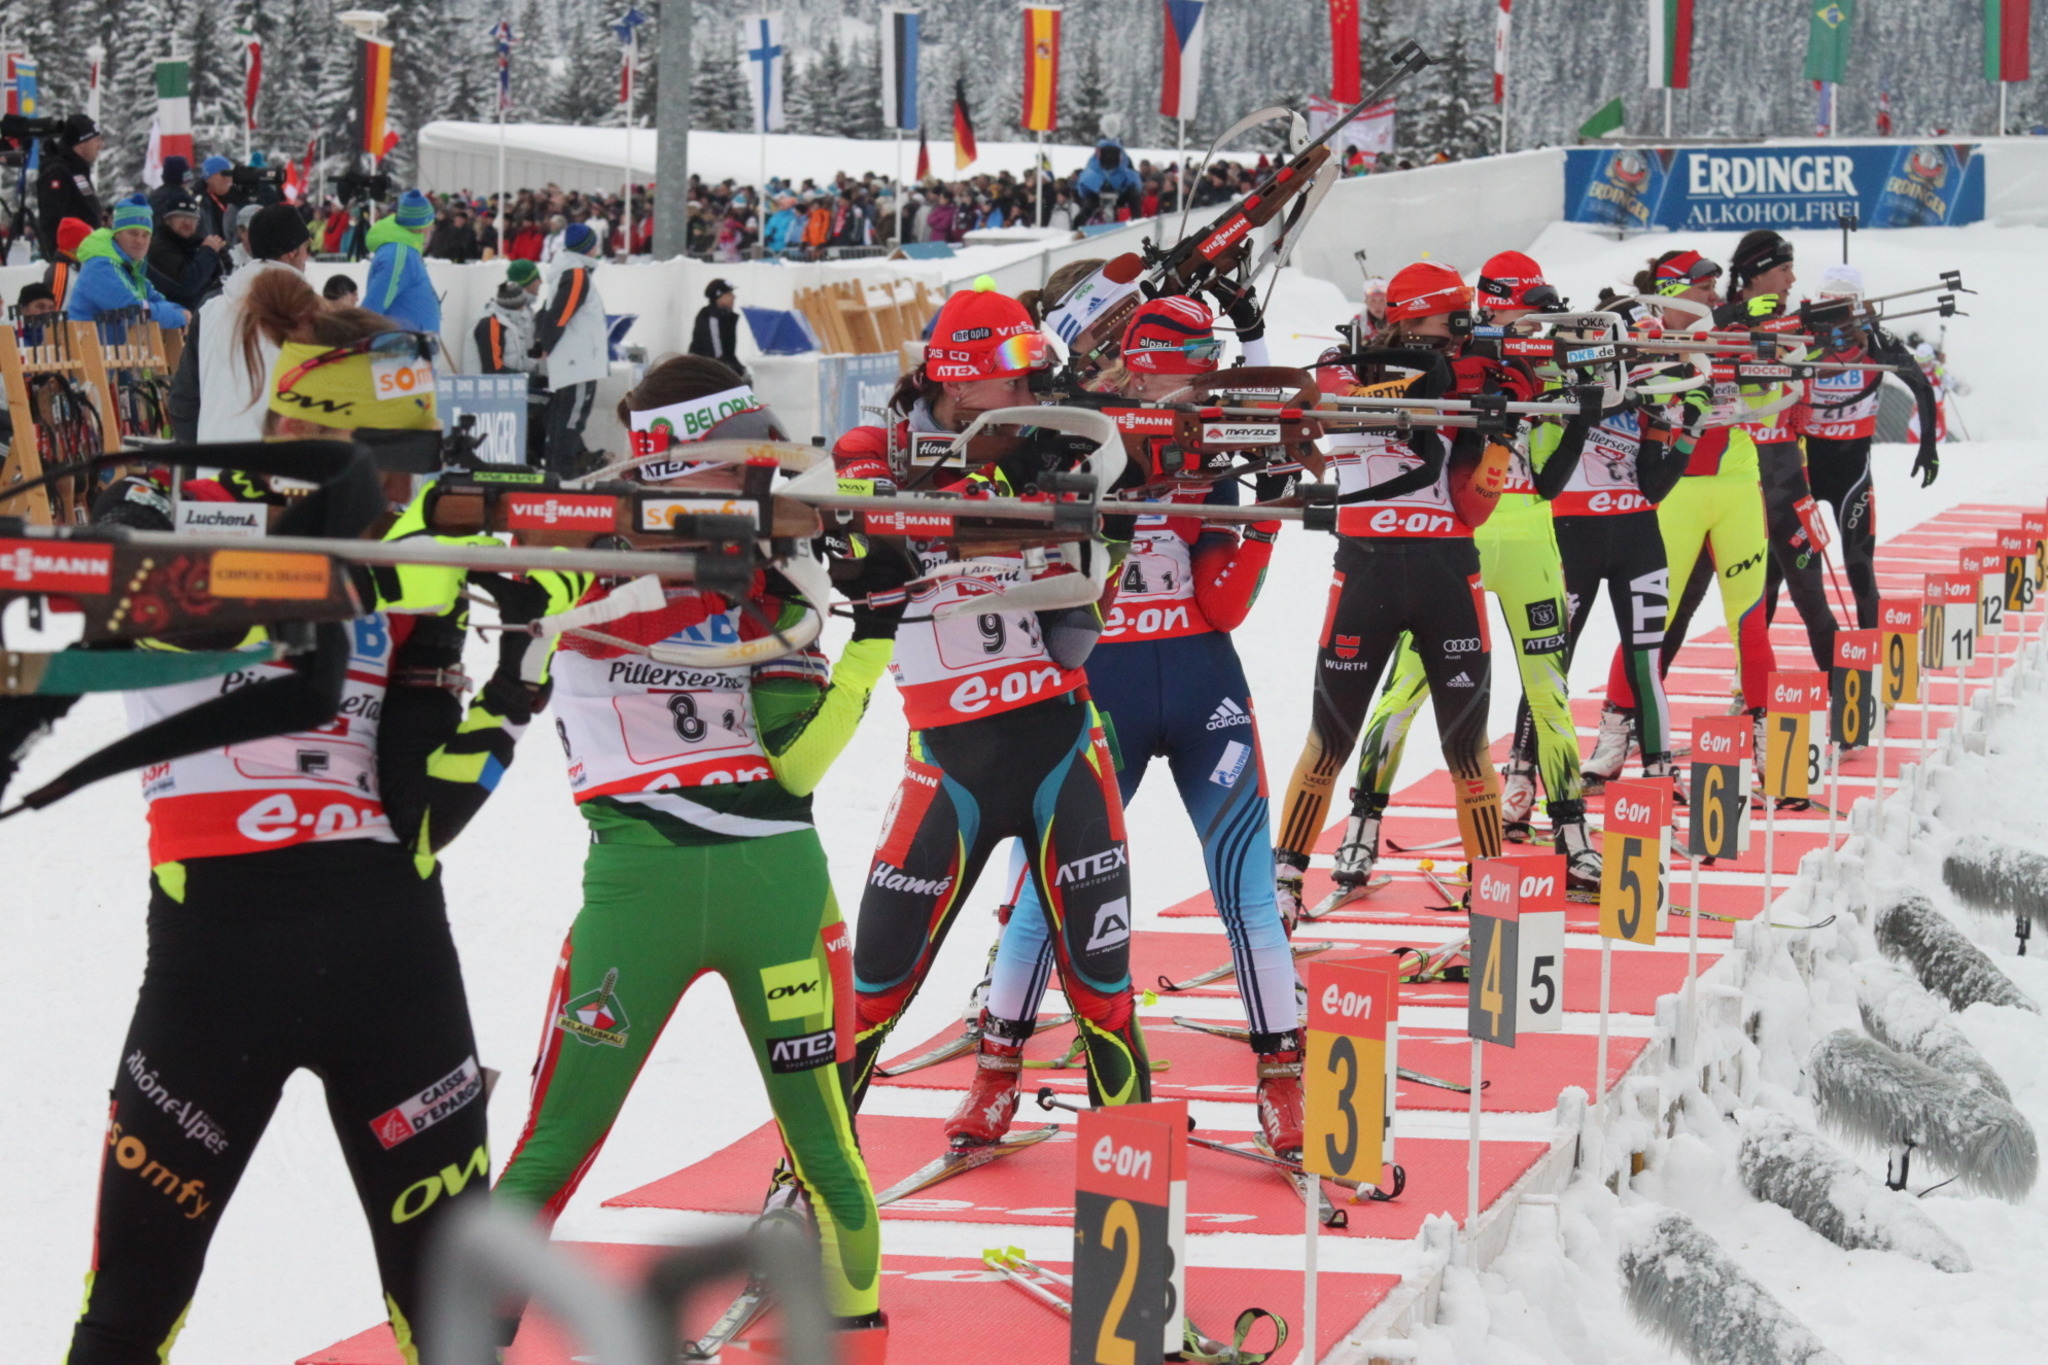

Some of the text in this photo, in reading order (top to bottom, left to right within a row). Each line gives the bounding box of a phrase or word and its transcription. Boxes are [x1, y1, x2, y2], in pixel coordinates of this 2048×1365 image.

[1688, 154, 1859, 197] ERDINGER
[1688, 201, 1861, 225] ALKOHOLFREI
[1202, 217, 1248, 254] VIESSMANN
[1504, 341, 1553, 353] VIESSMANN
[1568, 347, 1614, 363] DKB.de
[936, 365, 981, 377] ATEX
[1739, 366, 1792, 377] FIOCCHI
[1108, 413, 1173, 429] IESSMANN
[1225, 427, 1279, 437] MAYZUS
[185, 510, 247, 527] Luchon
[511, 499, 613, 524] VIESSMANN
[867, 511, 951, 530] VIESSMANN
[0, 547, 109, 582] ESSMANN
[1121, 560, 1149, 594] 4
[1629, 566, 1669, 645] ITA
[1982, 595, 2003, 626] 12
[976, 613, 1007, 656] 9
[1525, 633, 1566, 651] ATEX
[1951, 628, 1974, 661] 11
[1325, 657, 1369, 672] WÜRTH
[1888, 633, 1906, 702] 9
[1446, 680, 1476, 689] adidas
[666, 691, 708, 744] 8
[1205, 714, 1252, 731] adidas
[1842, 668, 1861, 745] 8
[1779, 716, 1798, 797] 7
[1703, 764, 1725, 856] 6
[870, 860, 953, 897] Hamé
[1054, 843, 1127, 887] ATEX
[1616, 837, 1642, 940] 5
[1480, 918, 1504, 1038] 4
[1529, 955, 1556, 1015] 5
[560, 1018, 624, 1044] BELARUSKALI
[420, 1068, 468, 1106] CAISSE
[1325, 1035, 1358, 1176] 3
[108, 1121, 212, 1221] somfy
[1094, 1199, 1141, 1365] 2
